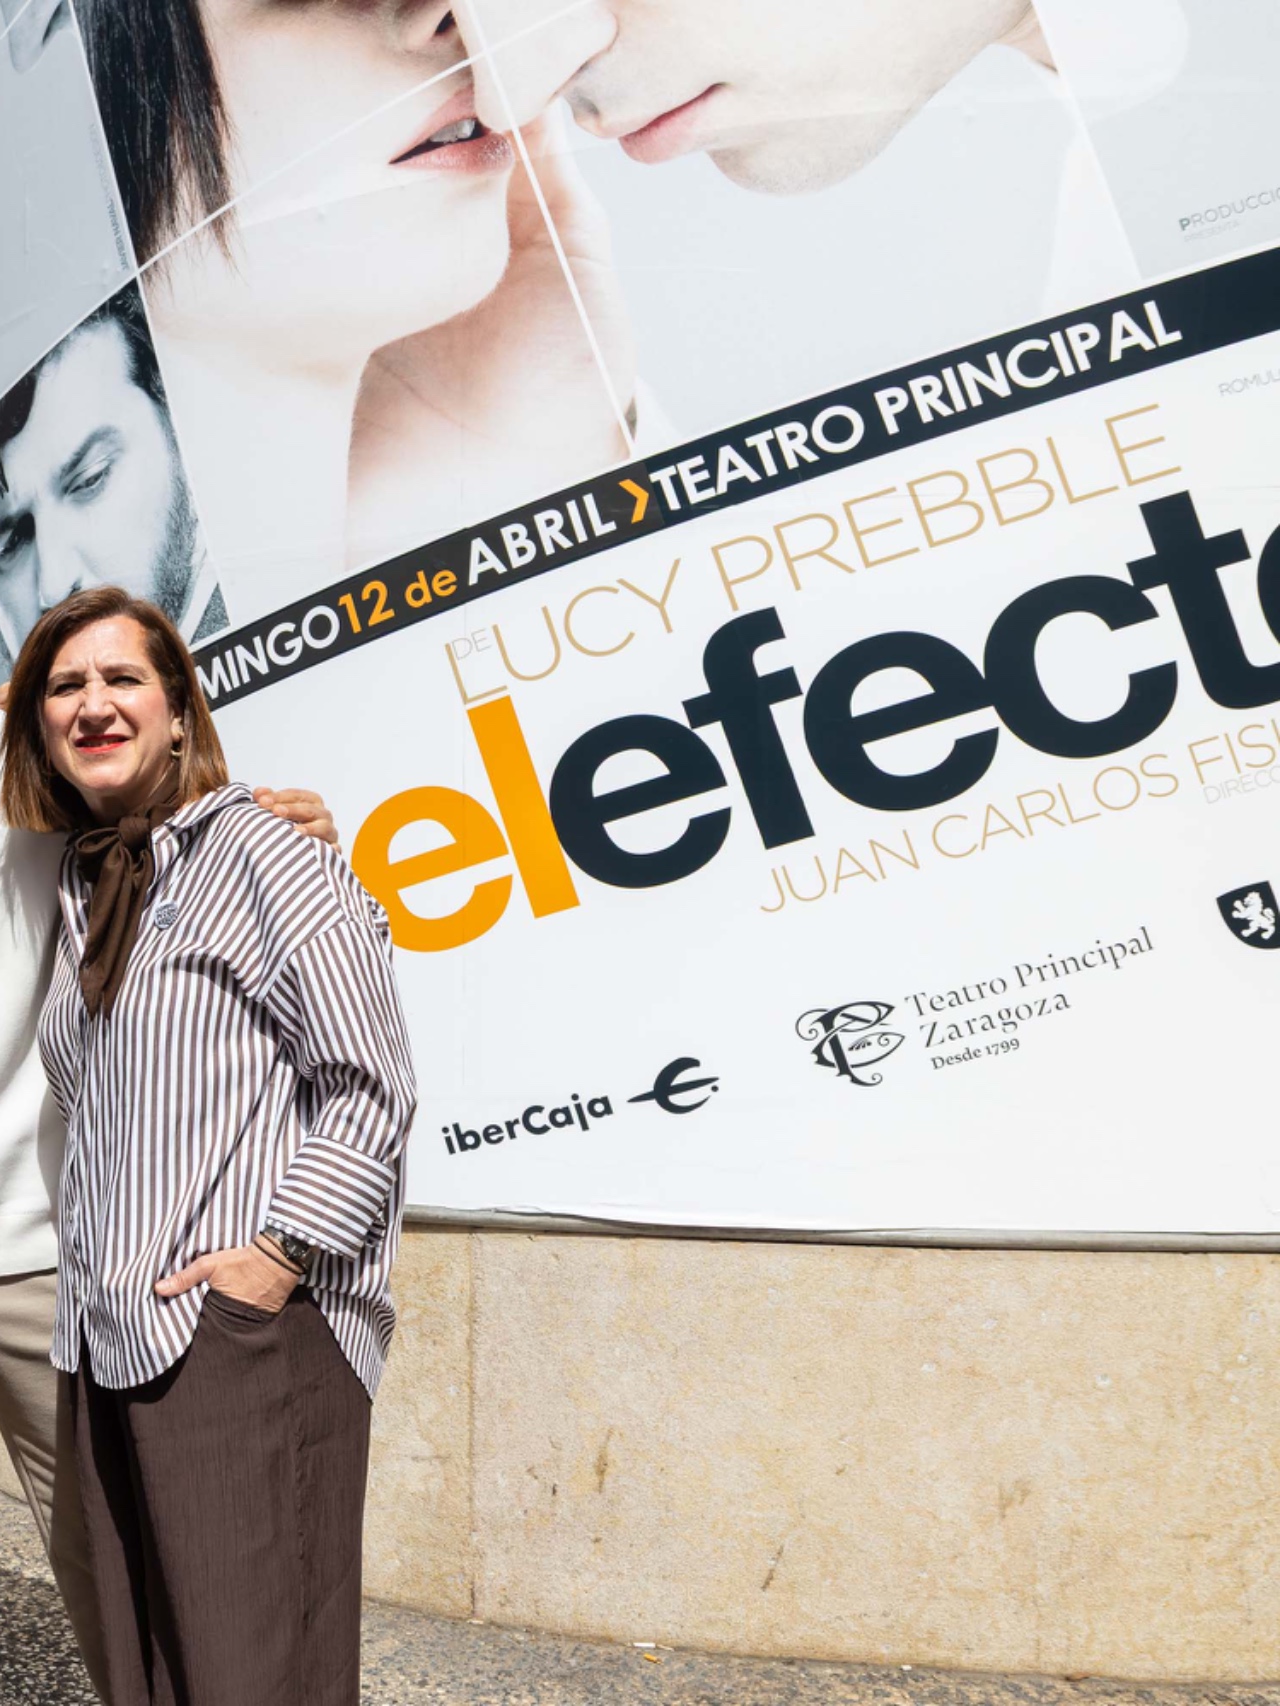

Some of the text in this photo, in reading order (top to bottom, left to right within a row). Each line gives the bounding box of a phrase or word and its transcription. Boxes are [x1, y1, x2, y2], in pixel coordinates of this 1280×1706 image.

[650, 300, 1182, 510] TEATRO PRINCIPAL
[1218, 368, 1280, 397] ROMUL
[194, 492, 617, 699] MINGO 12 de ABRIL
[445, 404, 1182, 705] LUCY PREBBLE
[452, 628, 492, 660] DE
[549, 489, 1280, 889] efect
[760, 718, 1280, 912] JUAN CARLOS FIS
[904, 926, 1155, 1018] Teatro Principal
[919, 993, 1071, 1049] Zaragoza
[930, 1038, 1020, 1070] Desde 1799
[441, 1093, 614, 1155] iberCaja
